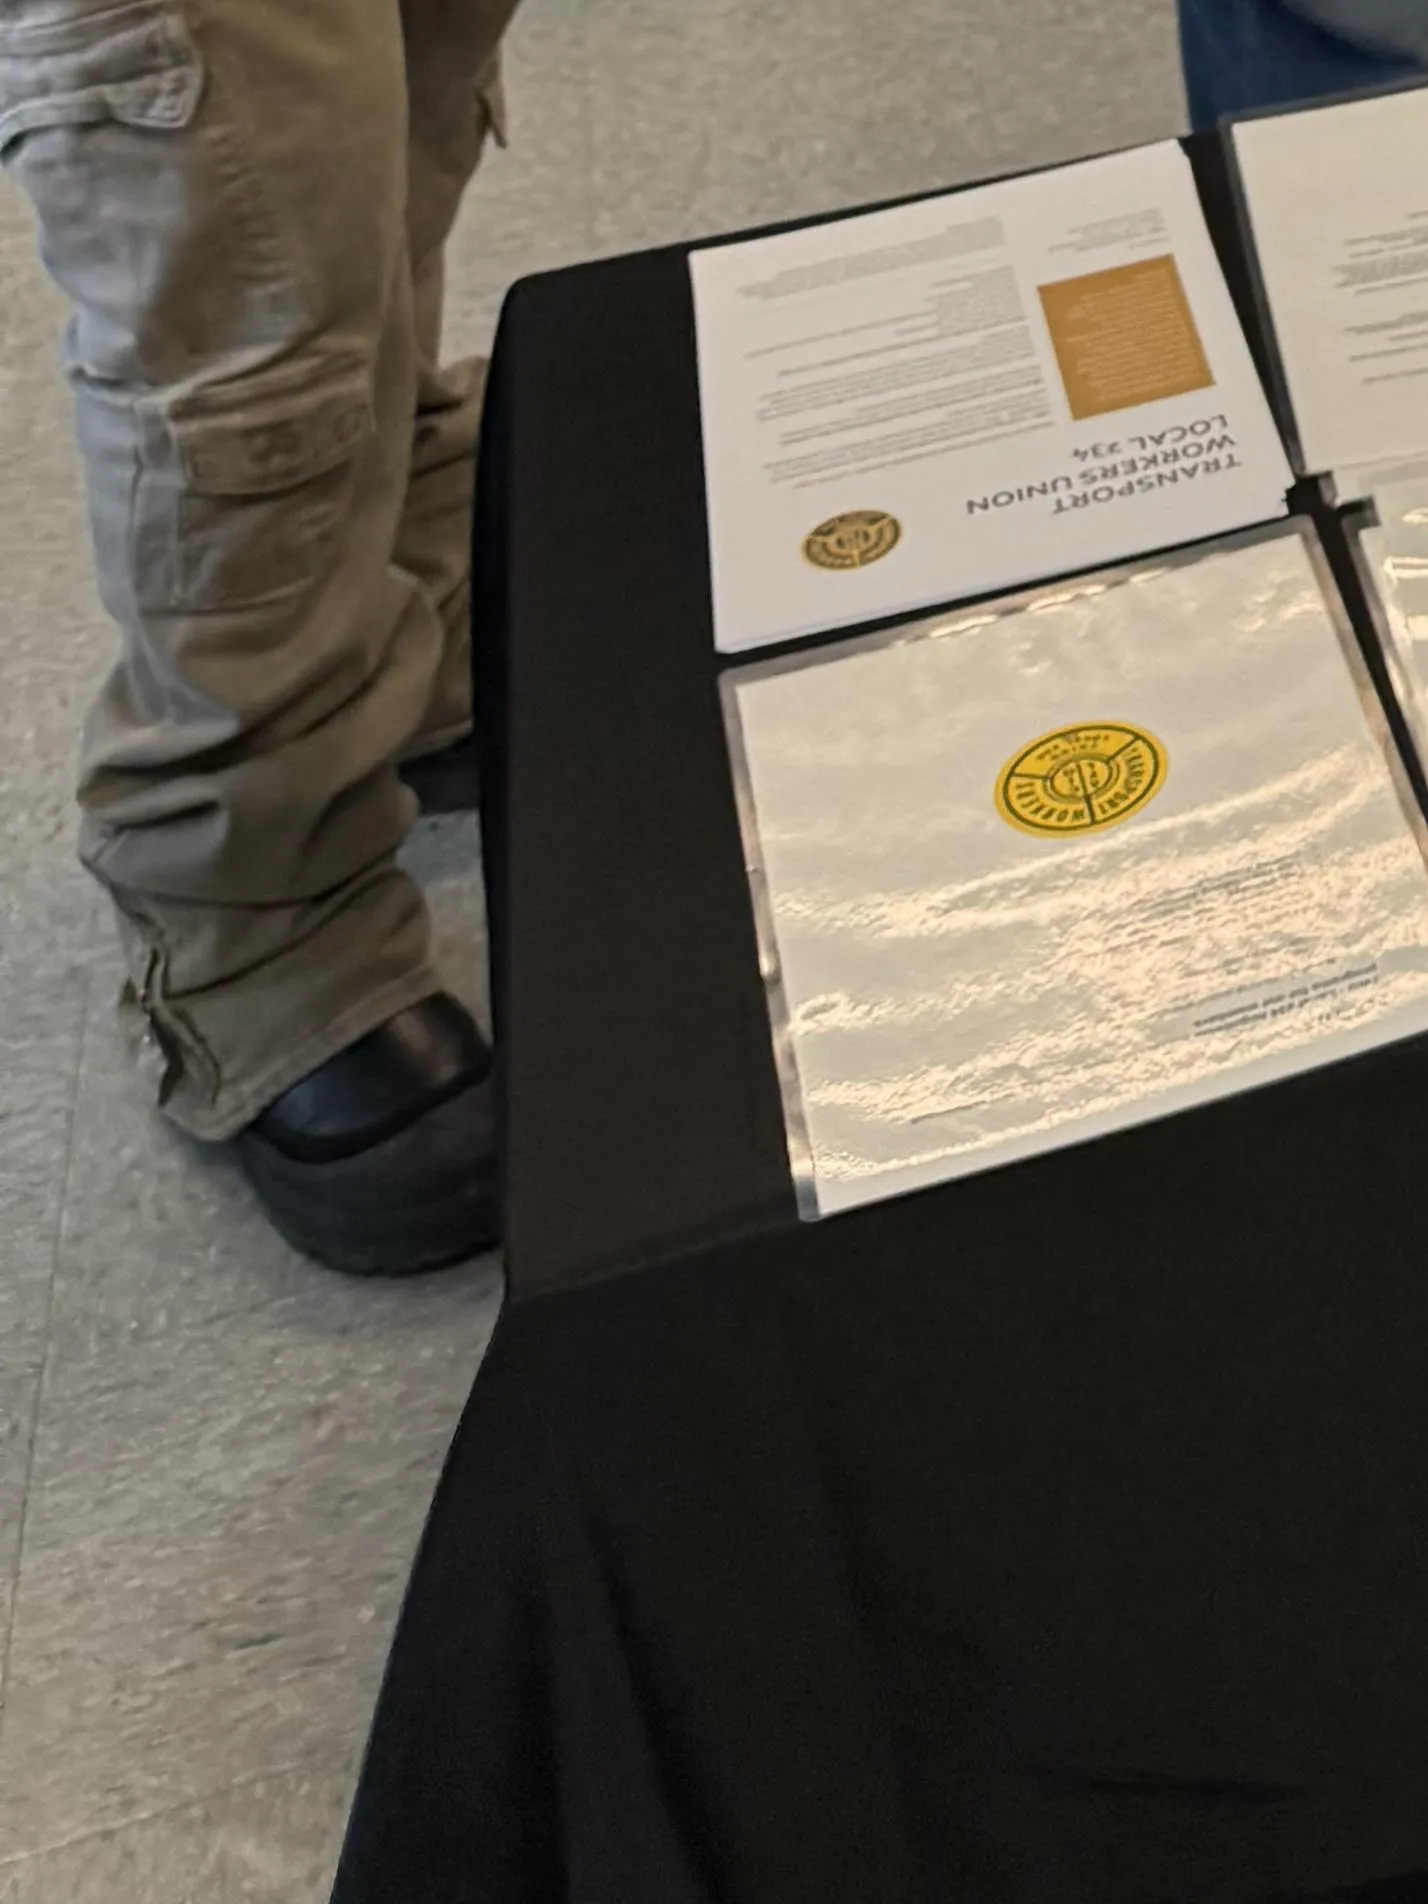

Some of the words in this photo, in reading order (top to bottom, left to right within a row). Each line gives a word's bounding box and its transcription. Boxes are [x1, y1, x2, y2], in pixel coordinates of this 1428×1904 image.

[1072, 441, 1124, 462] 234
[1128, 414, 1229, 451] LOCAL
[1079, 433, 1236, 486] WORKERS
[965, 476, 1073, 515] UNION
[1052, 452, 1243, 515] TRANSPORT
